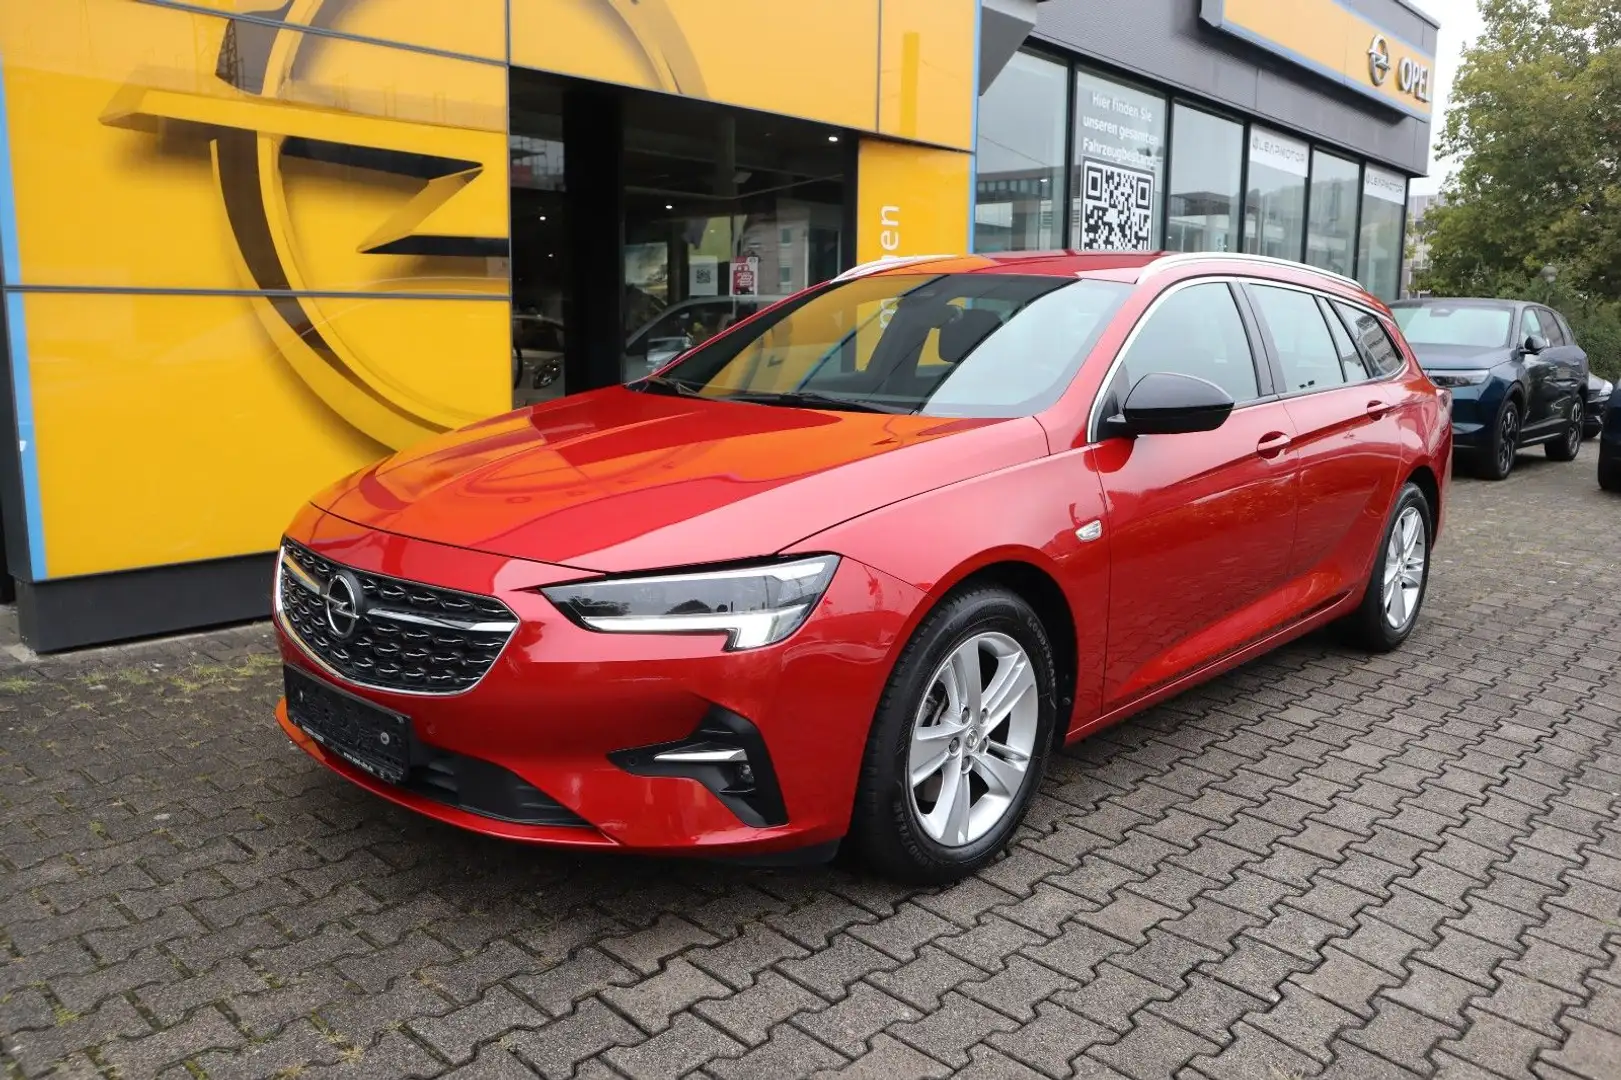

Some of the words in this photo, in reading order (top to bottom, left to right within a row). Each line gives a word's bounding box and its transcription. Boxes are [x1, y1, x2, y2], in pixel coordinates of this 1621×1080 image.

[1399, 56, 1431, 102] OPEL
[1092, 91, 1110, 109] Hier
[1112, 97, 1139, 117] finden
[1140, 105, 1153, 122] Sie
[1083, 115, 1118, 135] unseren
[1119, 125, 1158, 146] gesamten
